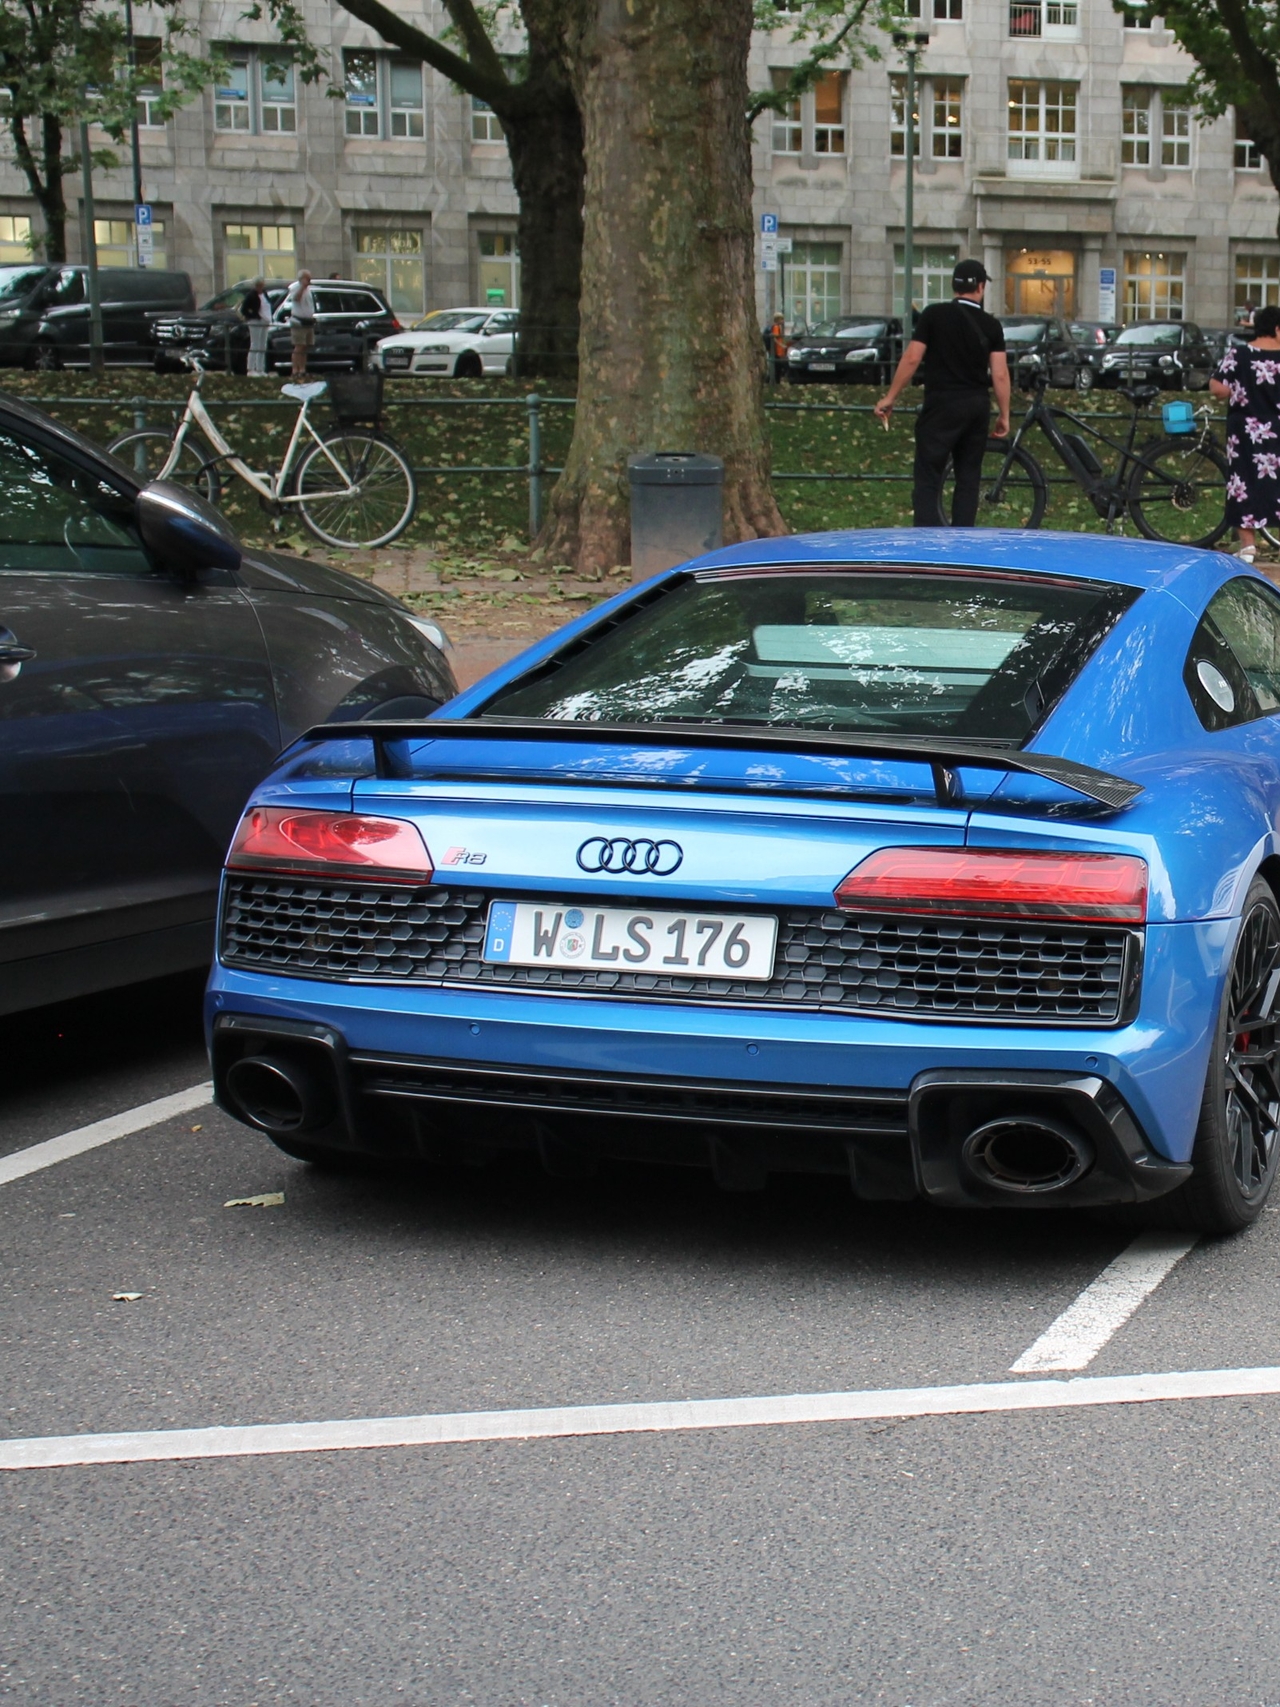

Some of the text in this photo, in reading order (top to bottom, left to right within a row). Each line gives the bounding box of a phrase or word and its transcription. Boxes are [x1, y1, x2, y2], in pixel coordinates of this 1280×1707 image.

[139, 207, 148, 224] P
[764, 215, 774, 232] P
[446, 848, 487, 865] R8
[493, 938, 505, 952] D
